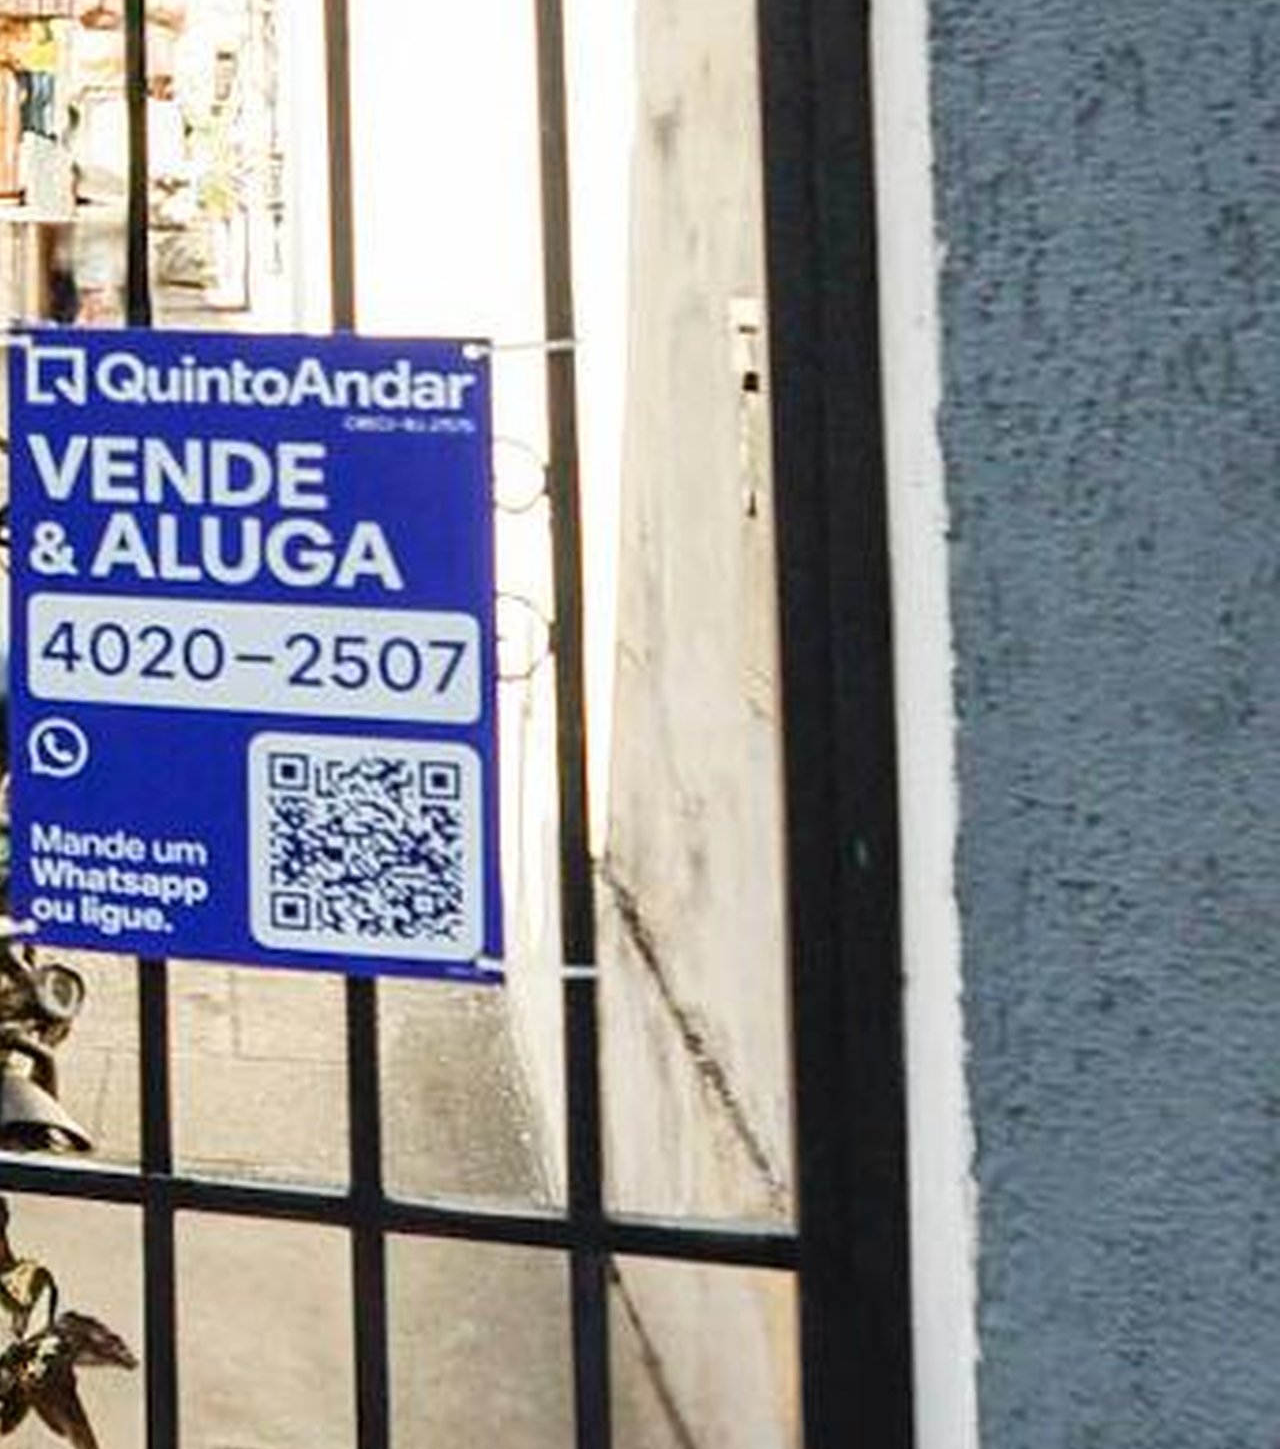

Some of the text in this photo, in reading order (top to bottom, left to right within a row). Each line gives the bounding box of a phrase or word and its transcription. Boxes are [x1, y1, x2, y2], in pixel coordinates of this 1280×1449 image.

[95, 351, 476, 410] QuintoAndar
[26, 433, 330, 509] VENDE
[28, 511, 406, 591] & ALUGA
[42, 621, 467, 694] 4020-2507
[30, 823, 209, 867] Mande um
[30, 858, 209, 907] Whatsapp
[31, 897, 175, 936] ou ligue.
